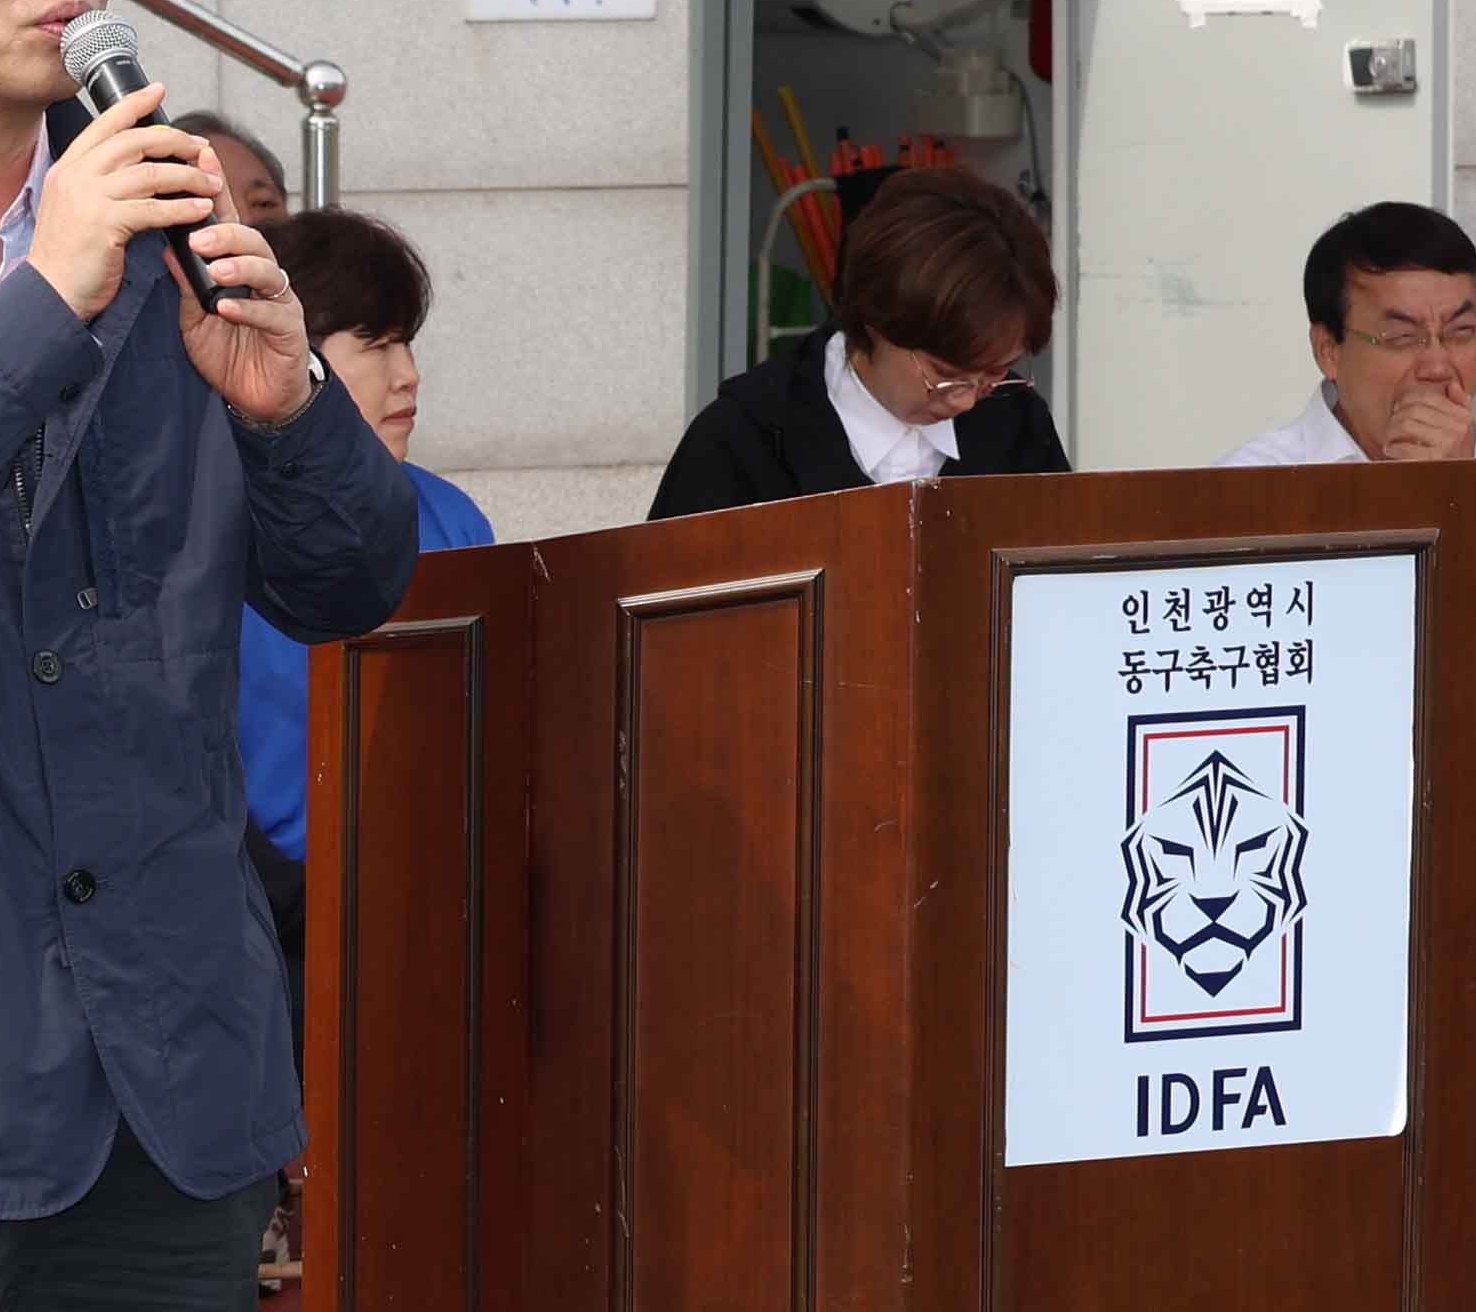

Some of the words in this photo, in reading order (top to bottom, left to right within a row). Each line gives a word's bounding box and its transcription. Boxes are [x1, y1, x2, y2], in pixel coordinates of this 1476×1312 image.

[1121, 580, 1314, 635] 인천광역시
[1117, 638, 1314, 695] 동구축구협회
[1136, 1065, 1287, 1137] IDFA
